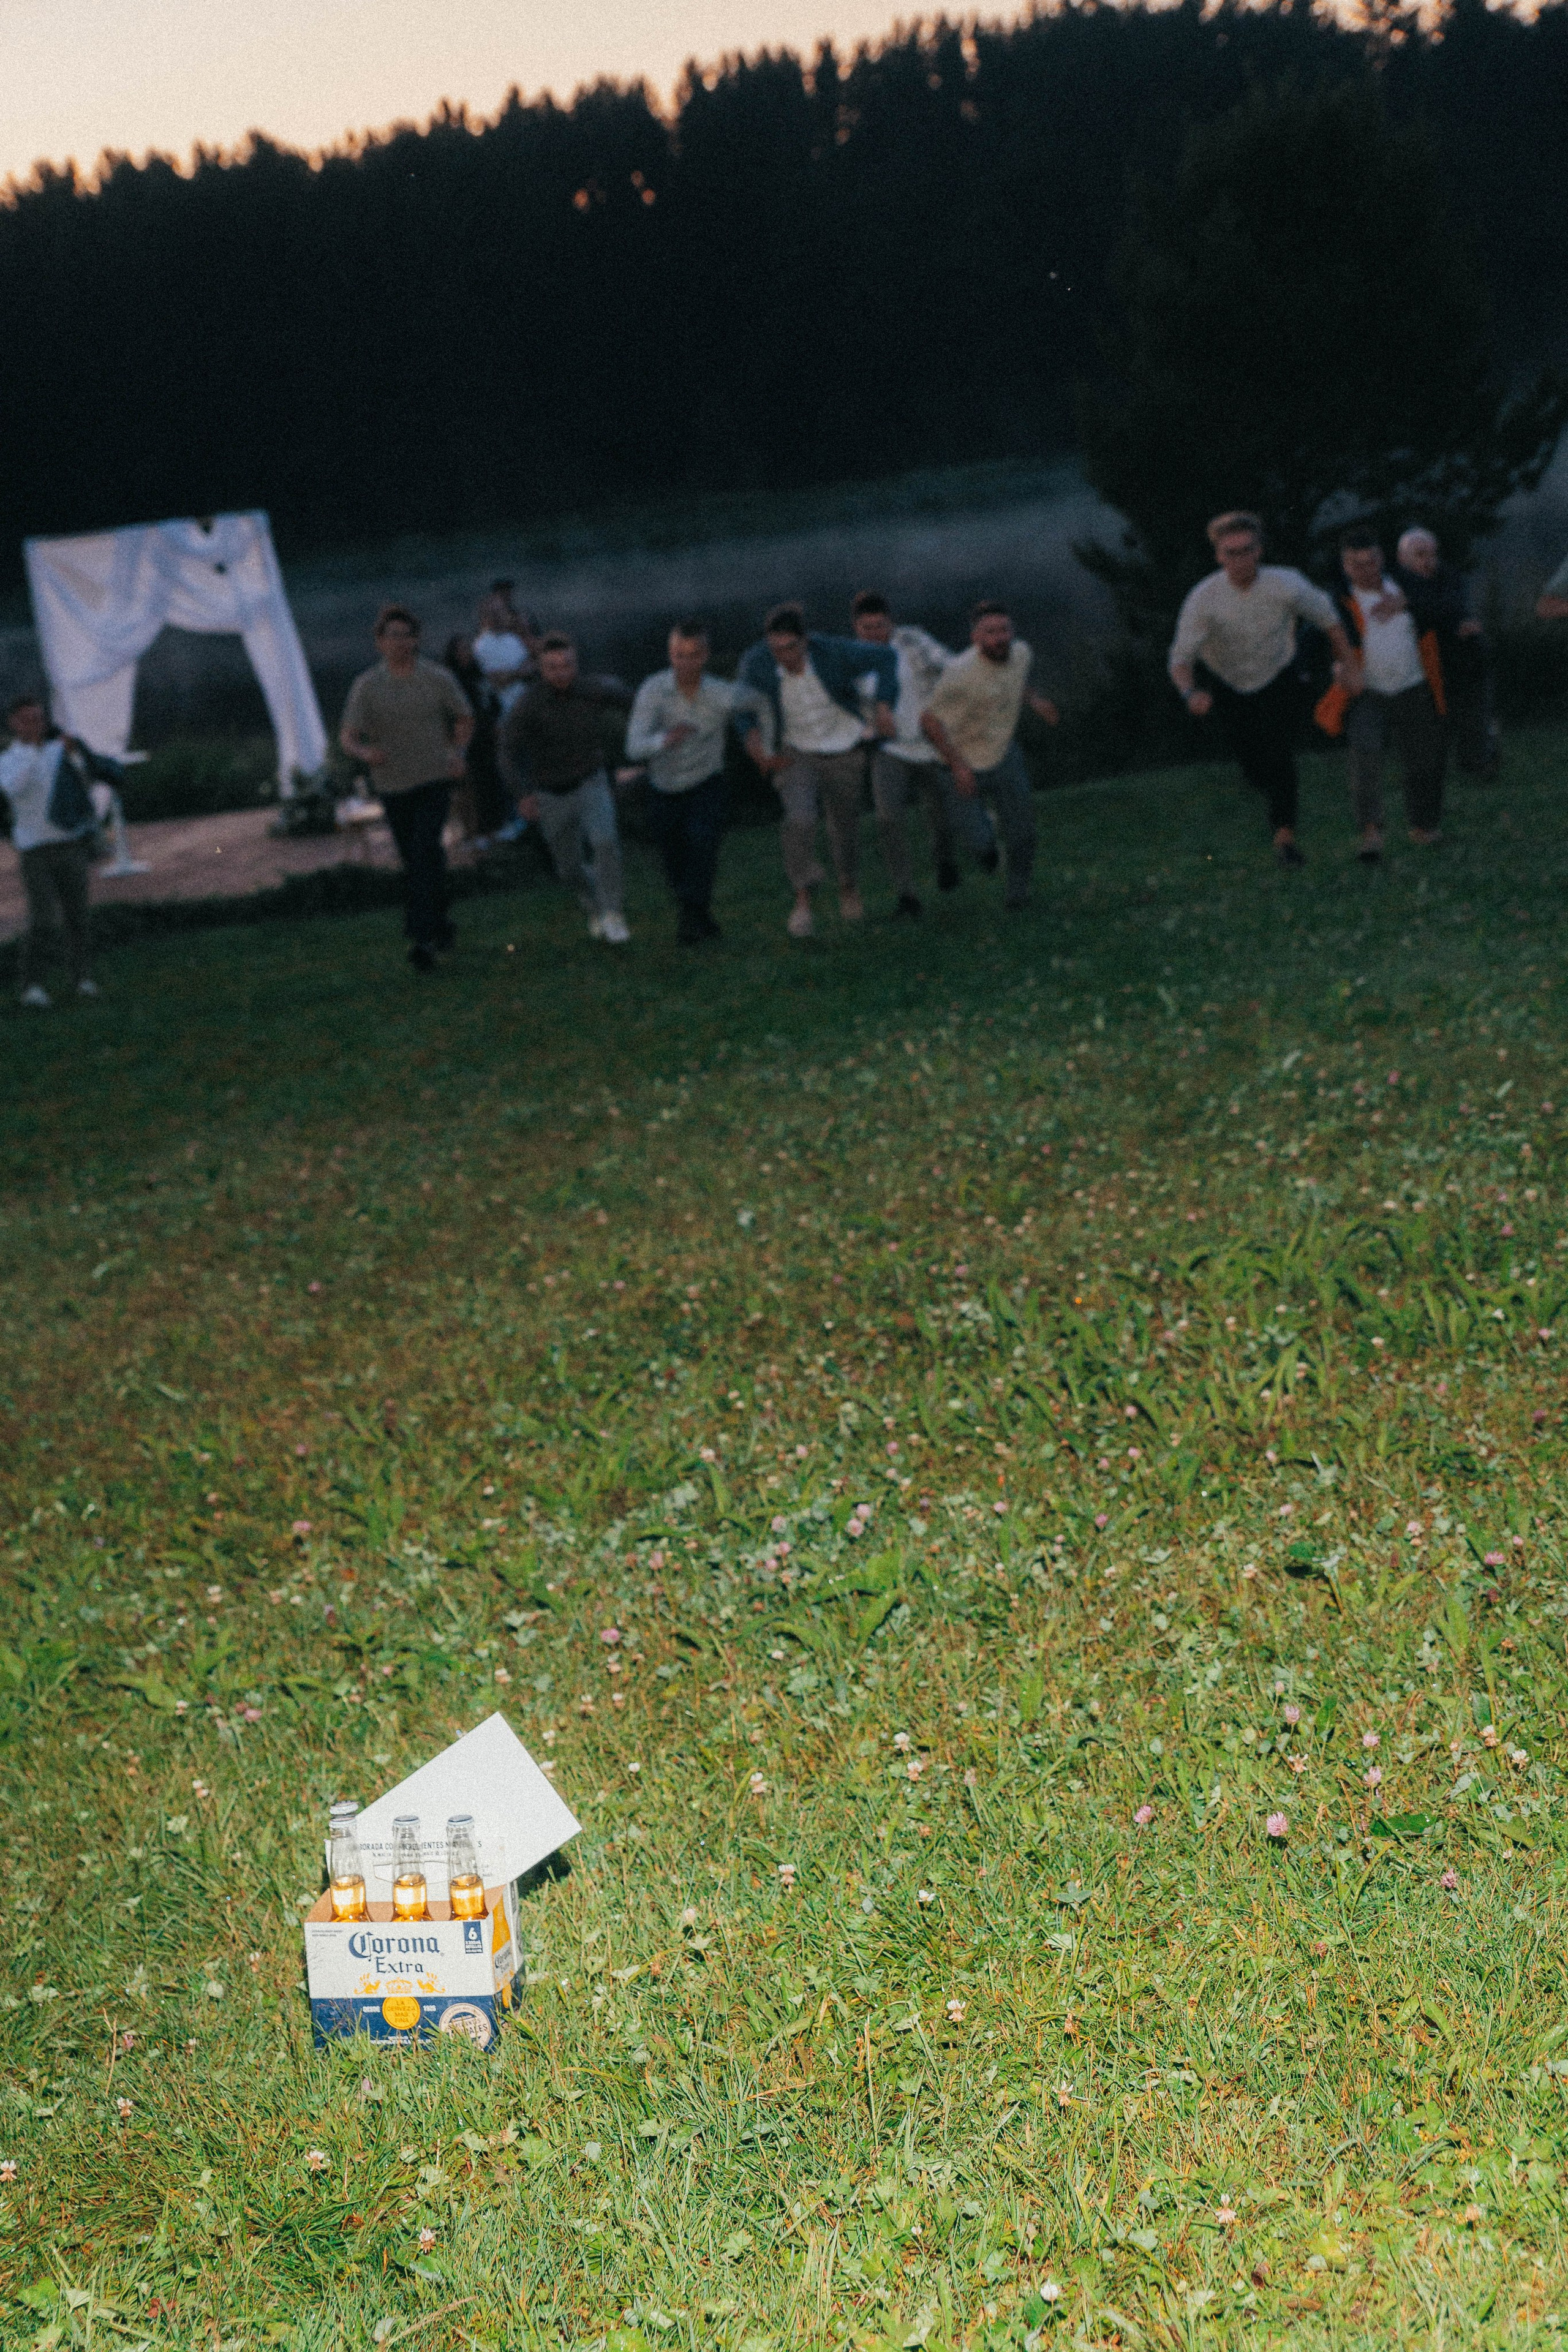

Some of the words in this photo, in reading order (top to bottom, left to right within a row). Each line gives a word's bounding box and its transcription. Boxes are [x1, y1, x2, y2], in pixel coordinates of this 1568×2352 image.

[469, 1927, 478, 1940] 6
[349, 1931, 440, 1962] Corona
[376, 1956, 424, 1973] Extra
